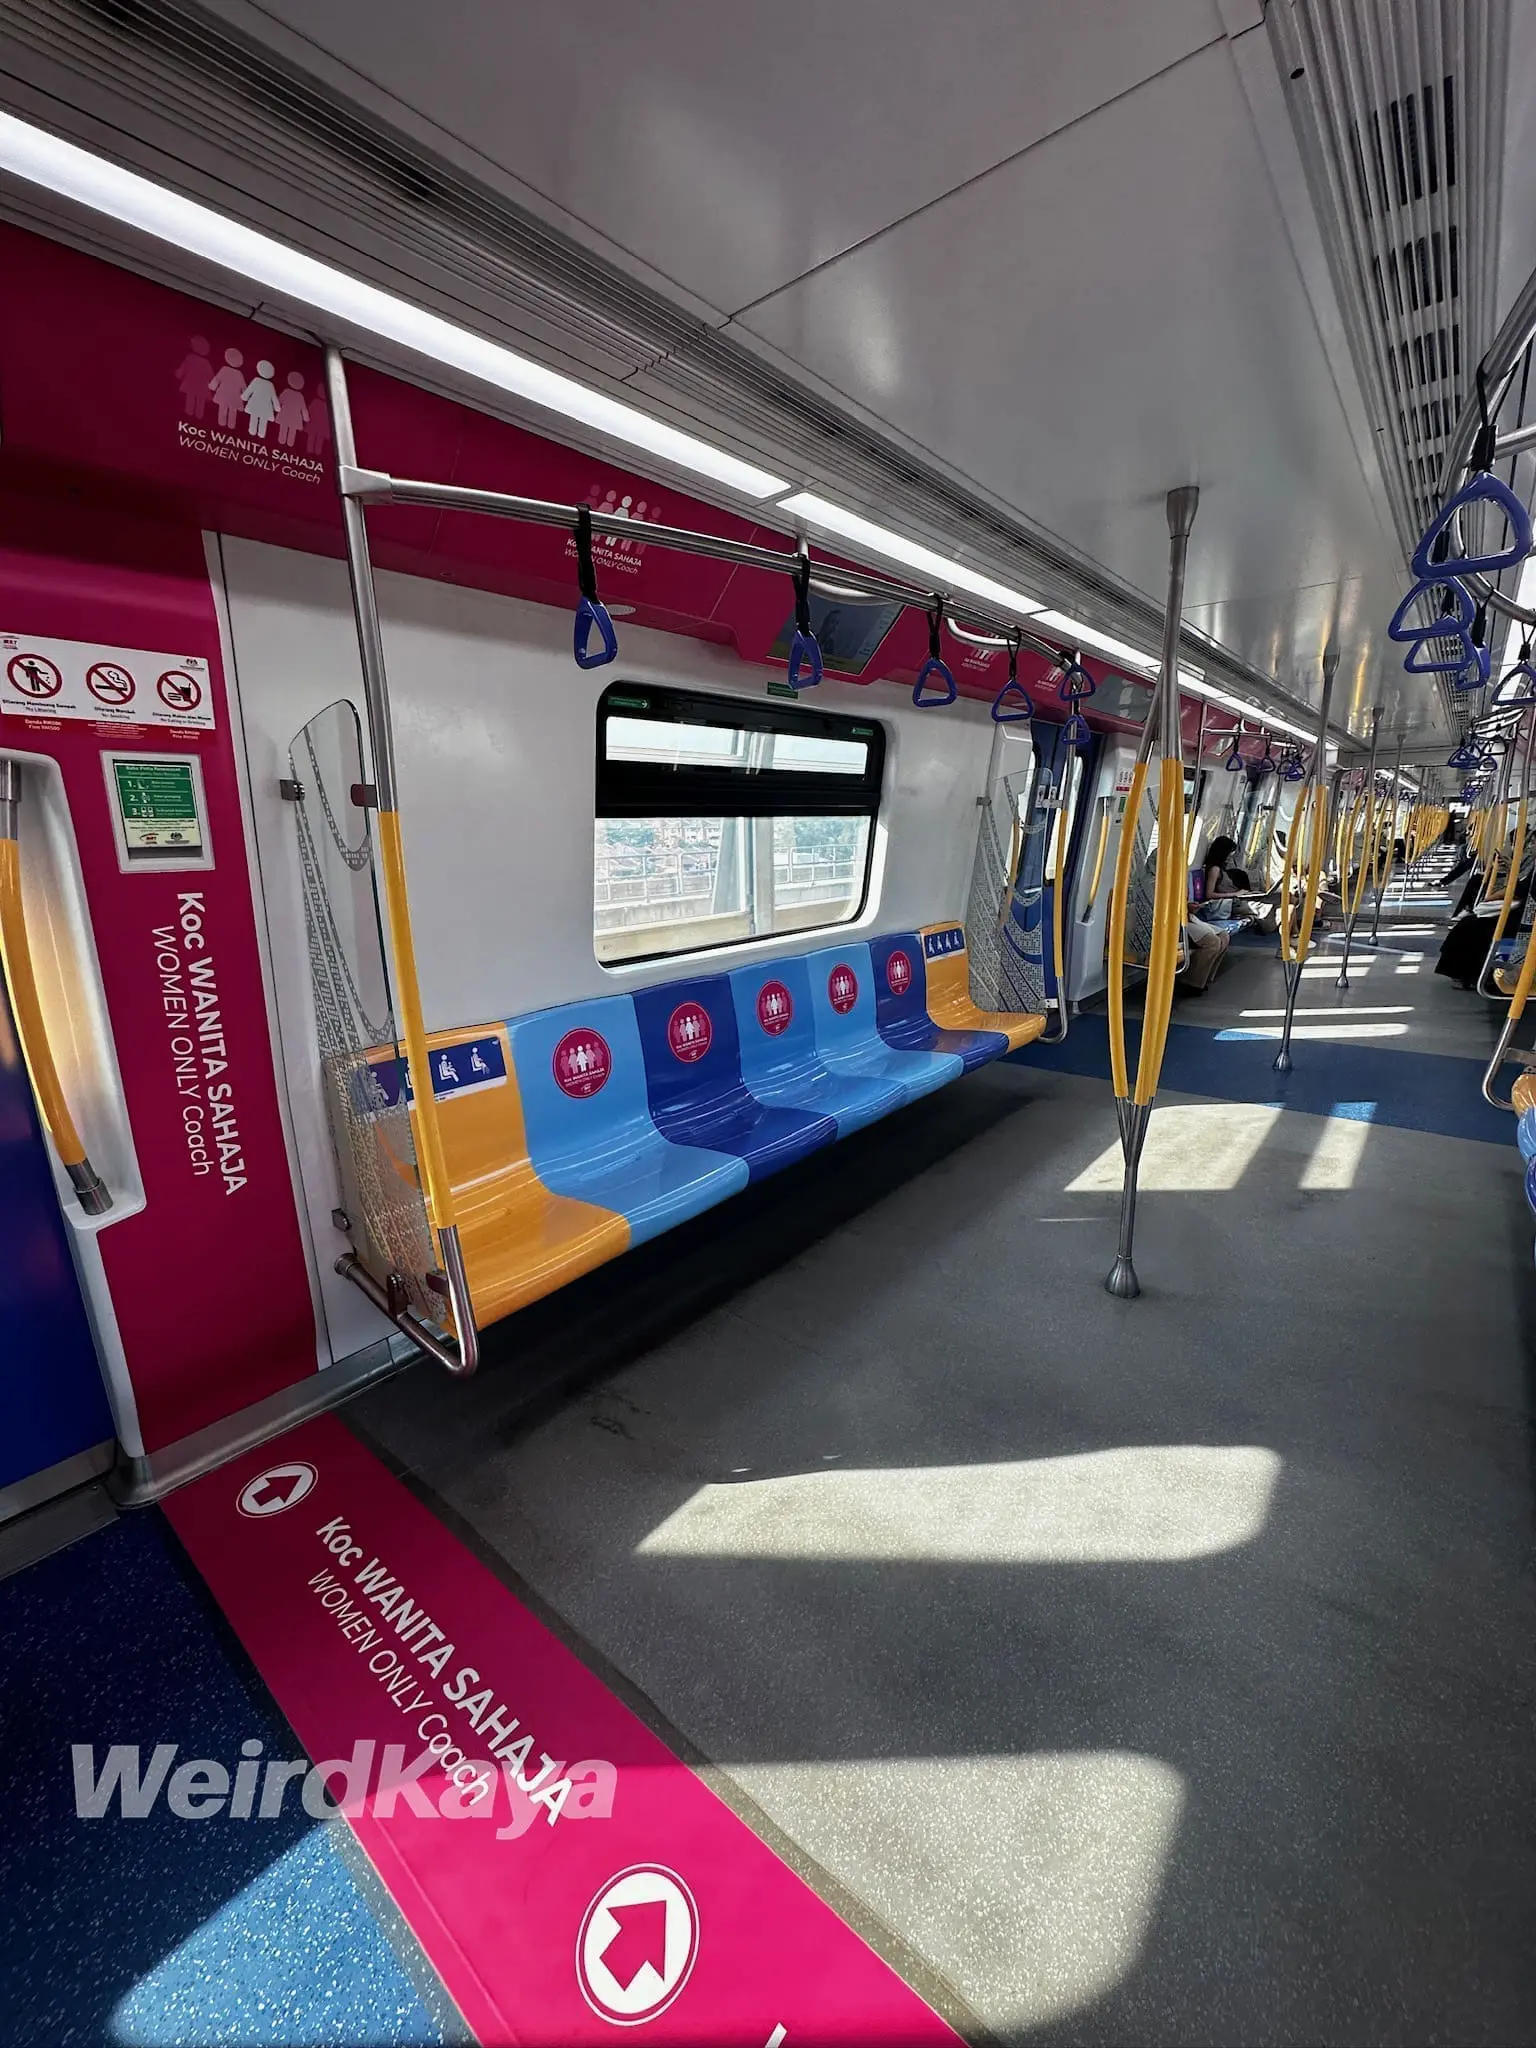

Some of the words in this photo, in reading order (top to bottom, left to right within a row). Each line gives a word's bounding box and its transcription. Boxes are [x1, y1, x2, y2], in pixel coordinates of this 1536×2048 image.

[178, 420, 207, 438] Koc
[210, 430, 268, 457] WANITA
[272, 449, 324, 473] SAHAJA
[179, 435, 240, 461] WOMEN
[243, 454, 280, 472] ONLY
[281, 465, 321, 484] Coach
[591, 546, 613, 559] ANITA
[614, 552, 642, 566] SAHAJA
[177, 892, 205, 950] Koc
[151, 925, 190, 1029] WOMEN
[188, 956, 228, 1080] WANITA
[171, 1037, 202, 1099] ONLY
[182, 1105, 215, 1176] Coach
[208, 1083, 248, 1196] SAHAJA
[308, 1568, 384, 1654] WOMEN
[369, 1649, 434, 1714] ONLY
[417, 1713, 492, 1805] Coach
[315, 1516, 364, 1567] Koc
[354, 1557, 457, 1679] WANITA
[443, 1668, 574, 1826] SAHAJA
